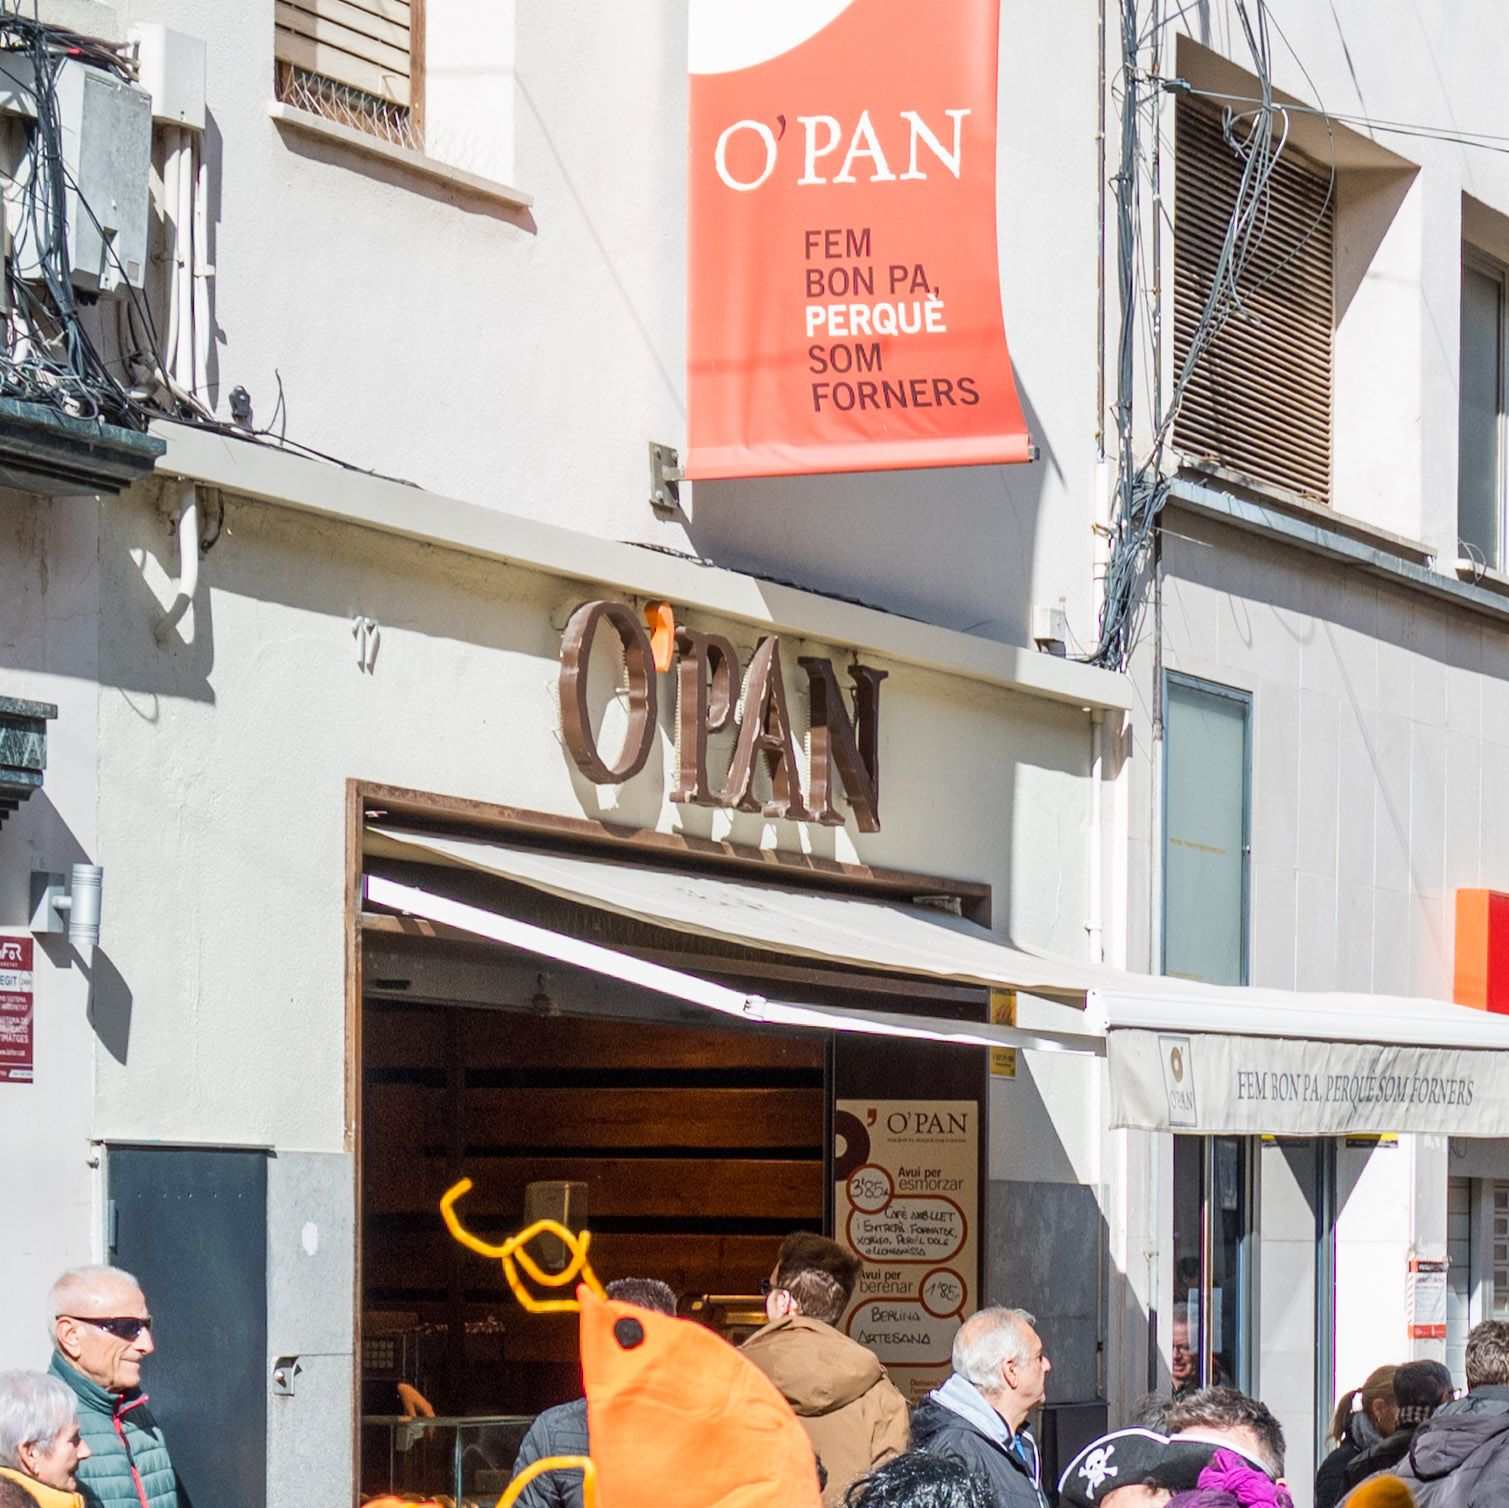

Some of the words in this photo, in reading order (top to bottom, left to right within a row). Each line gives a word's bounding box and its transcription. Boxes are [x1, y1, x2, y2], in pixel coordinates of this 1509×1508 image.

[714, 108, 971, 191] O'PAN
[804, 227, 871, 260] FEM
[805, 266, 874, 298] BON
[889, 263, 939, 299] PA,
[806, 292, 946, 337] PERQUÈ
[808, 342, 883, 374] SOM
[811, 377, 980, 412] FORNERS
[559, 600, 888, 833] O'PAN
[1238, 1071, 1268, 1100] FEM
[1271, 1072, 1302, 1101] BON
[1327, 1068, 1377, 1113] PERQUÈ
[1377, 1075, 1411, 1103] SOM
[1410, 1076, 1474, 1105] FORNERS
[887, 1112, 968, 1134] O'PAN
[898, 1167, 920, 1177] Avui
[925, 1169, 941, 1181] per
[899, 1178, 964, 1191] esmorzar
[860, 1280, 913, 1294] berenar
[884, 1271, 901, 1284] per
[857, 1330, 931, 1345] ARTESANA
